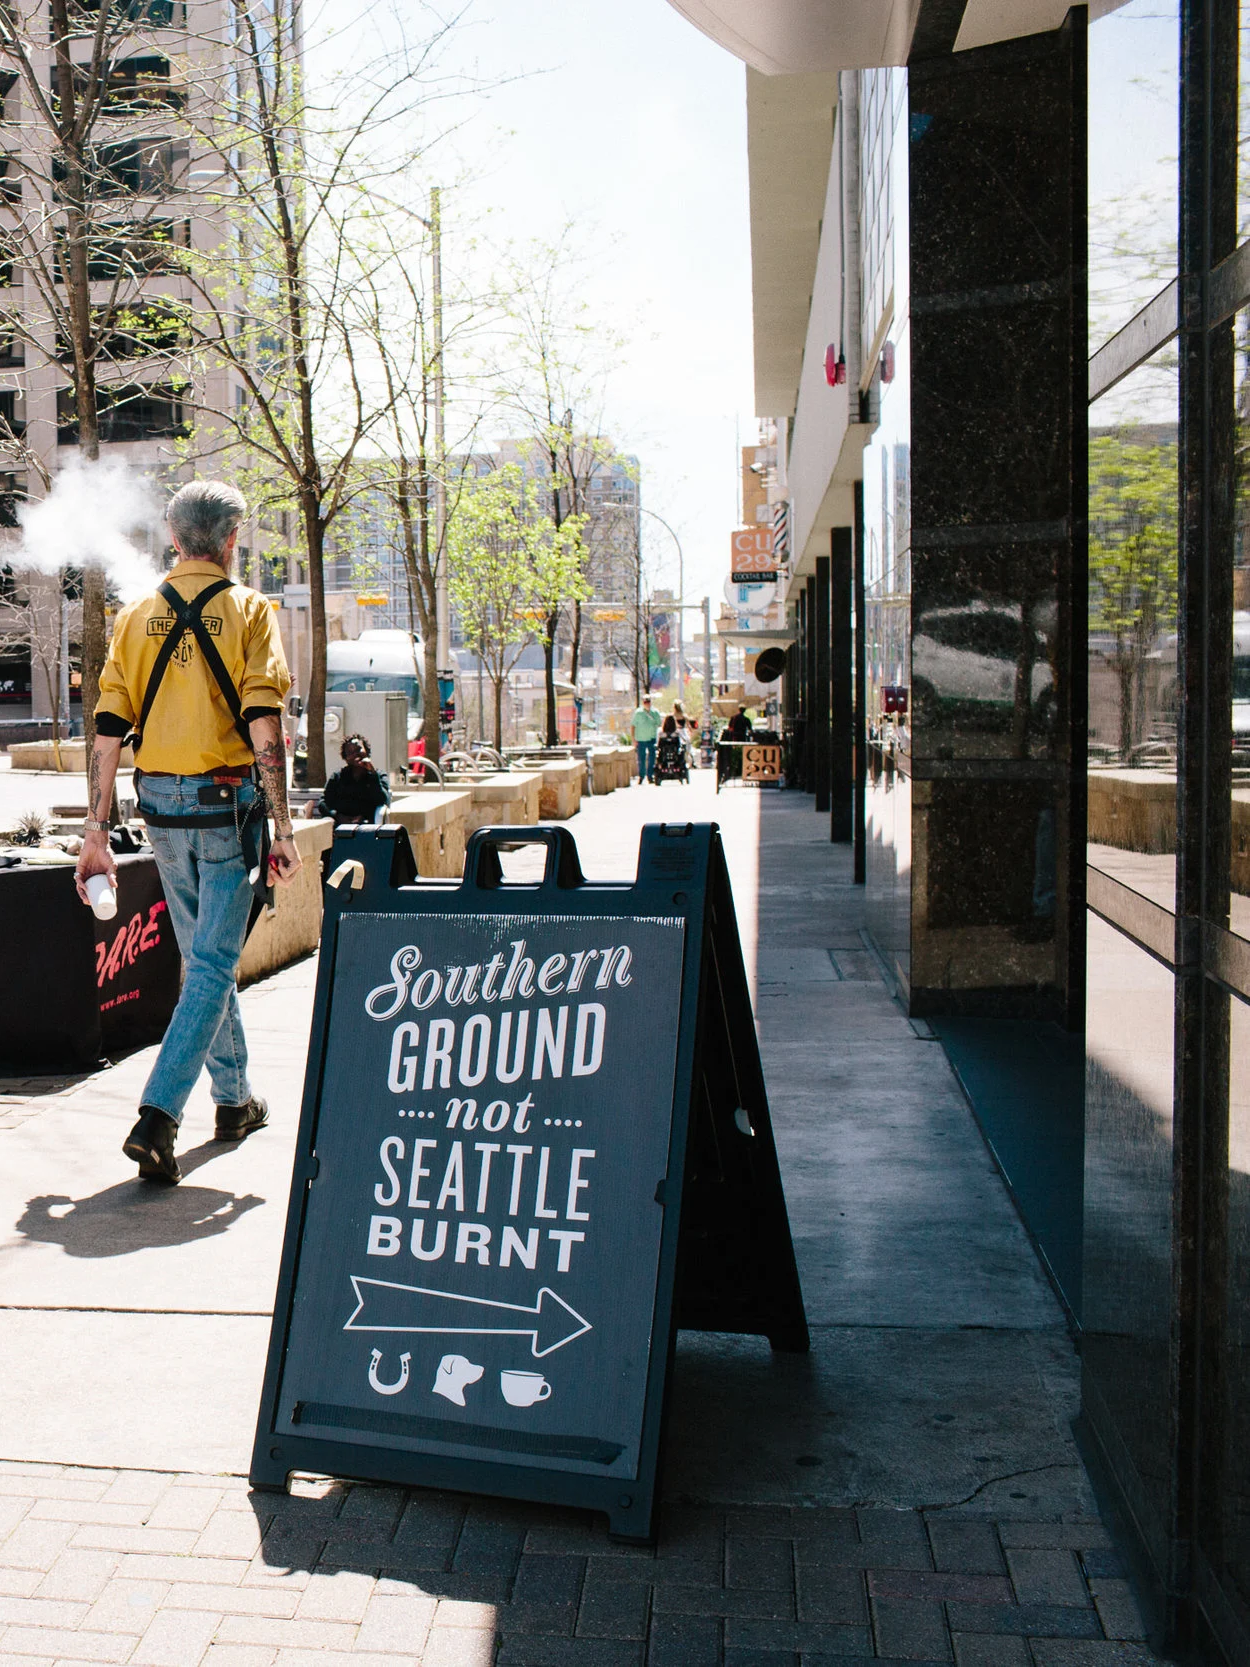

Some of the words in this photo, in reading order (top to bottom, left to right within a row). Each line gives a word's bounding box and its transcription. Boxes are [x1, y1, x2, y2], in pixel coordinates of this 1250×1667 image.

[735, 533, 771, 551] CU
[733, 572, 760, 580] COCKTAIL
[762, 571, 775, 579] BAR
[736, 553, 771, 570] 29
[150, 620, 172, 632] THE
[746, 748, 776, 763] CU
[364, 938, 633, 1022] Southern
[387, 1002, 607, 1094] GROUND
[445, 1092, 535, 1134] not
[373, 1135, 596, 1221] SEATTLE
[366, 1214, 585, 1272] BURNT
